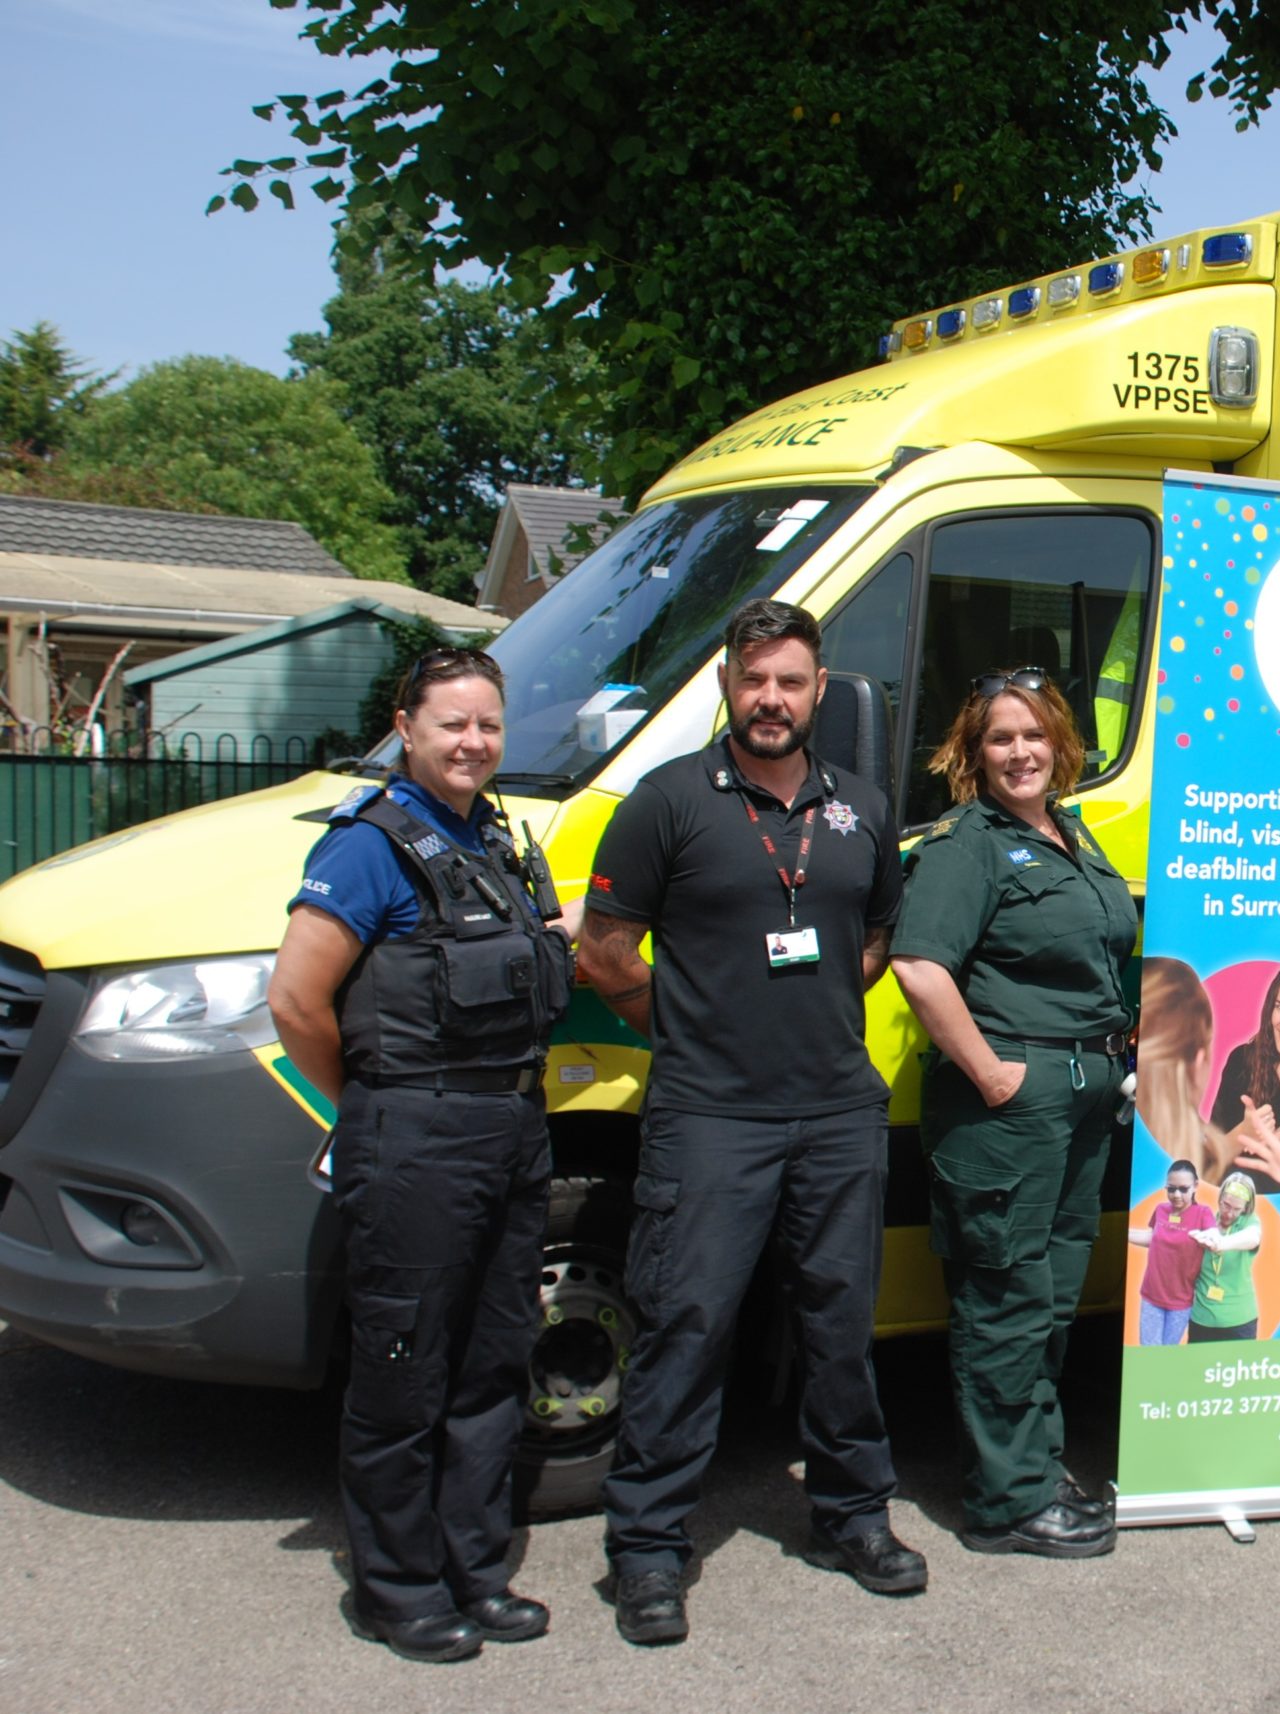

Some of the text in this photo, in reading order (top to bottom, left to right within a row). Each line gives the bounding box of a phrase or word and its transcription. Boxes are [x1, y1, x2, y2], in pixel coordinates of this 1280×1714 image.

[1128, 352, 1199, 383] 1375
[824, 383, 908, 407] Coast
[1113, 384, 1209, 414] VPPSE
[672, 418, 848, 471] BULANCE
[1180, 819, 1244, 848] blind,
[1008, 849, 1032, 864] NHS
[1166, 856, 1276, 882] deafblind
[303, 878, 332, 896] OLICE
[1203, 893, 1223, 916] in
[1139, 1402, 1171, 1420] Tel:
[1177, 1398, 1233, 1418] 01372
